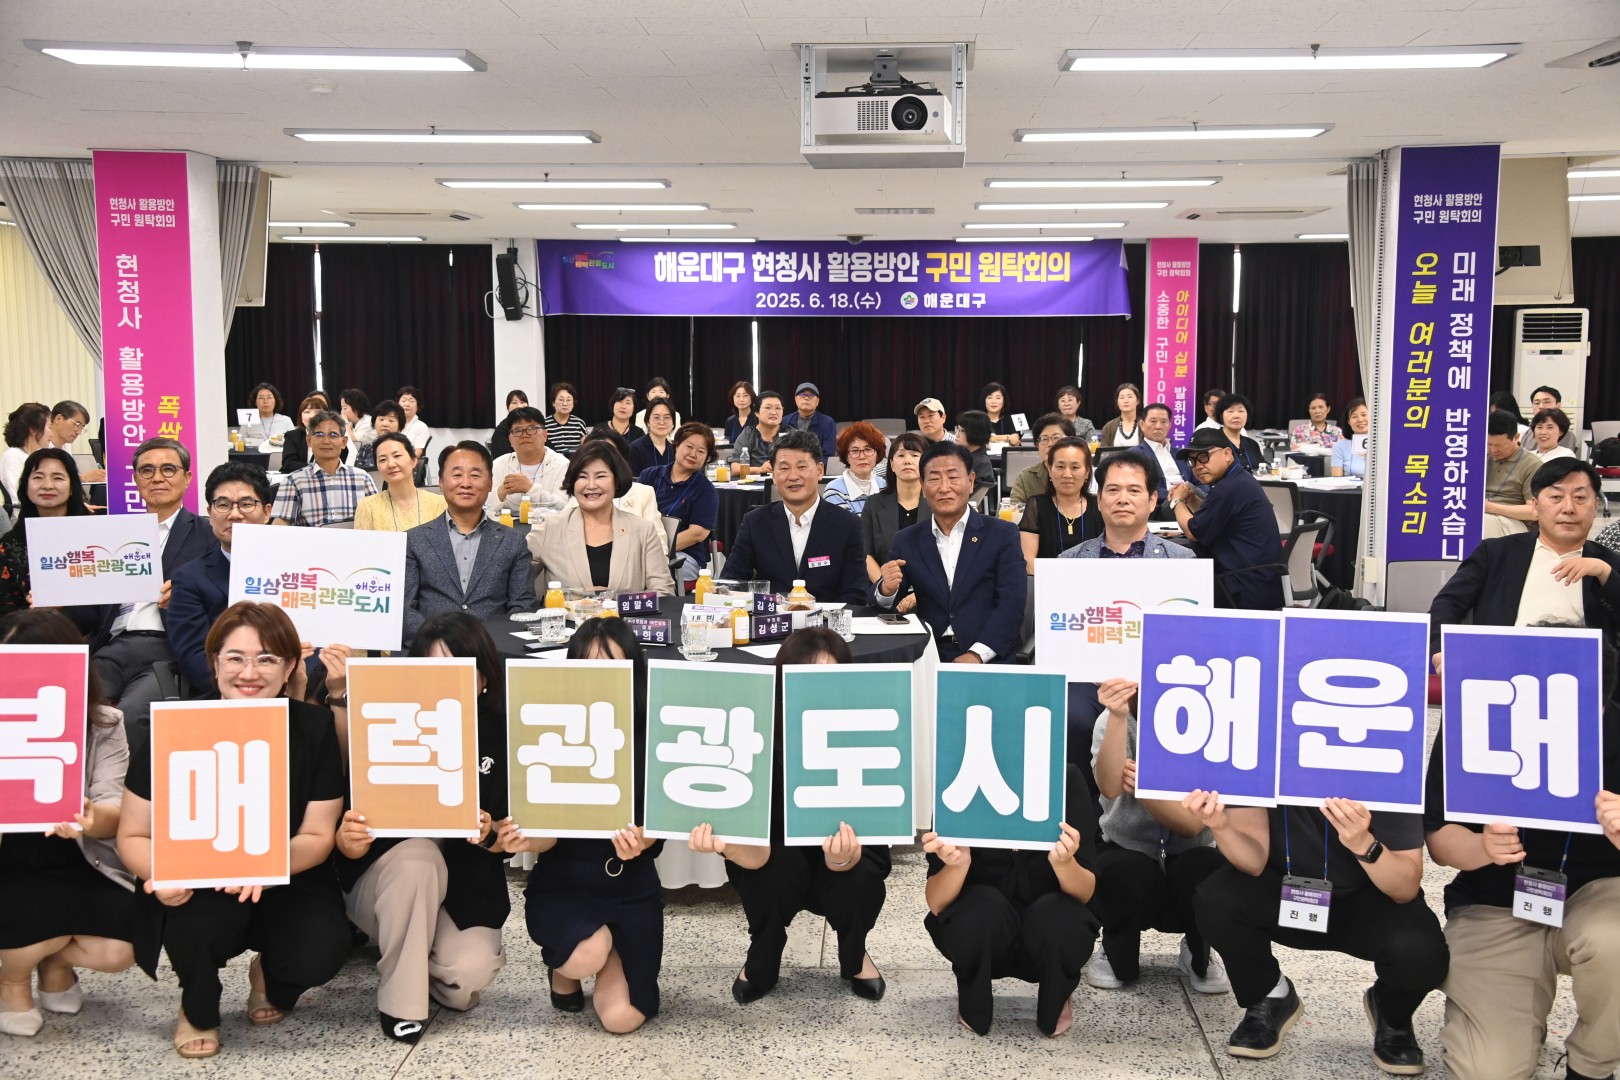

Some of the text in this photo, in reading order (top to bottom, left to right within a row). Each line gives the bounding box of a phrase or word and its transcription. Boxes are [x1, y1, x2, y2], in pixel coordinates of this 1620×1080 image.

[109, 197, 175, 212] 현청사 활용방안
[1413, 193, 1483, 208] 현청사 활용방안
[110, 213, 176, 228] 구민 원탁회의
[1413, 209, 1482, 224] 구민 원탁회의
[654, 251, 1071, 283] 해운대구 현청사 활용방안 구민 원탁회의
[1450, 251, 1477, 303] 미래
[115, 253, 142, 330] 현청사
[755, 291, 882, 310] 2025. 6. 18.(수)
[923, 292, 987, 309] 해운대구
[1156, 289, 1170, 330] 소중한
[1175, 289, 1189, 344] 아이디어
[1155, 337, 1168, 363] 구민
[1447, 313, 1473, 391] 정책에
[119, 346, 147, 447] 활용방안
[1401, 252, 1439, 535] 오늘 여러분의 목소리
[246, 413, 252, 422] 7
[1018, 417, 1023, 427] 9
[1173, 386, 1187, 441] 발휘하는
[355, 579, 391, 593] 해운대
